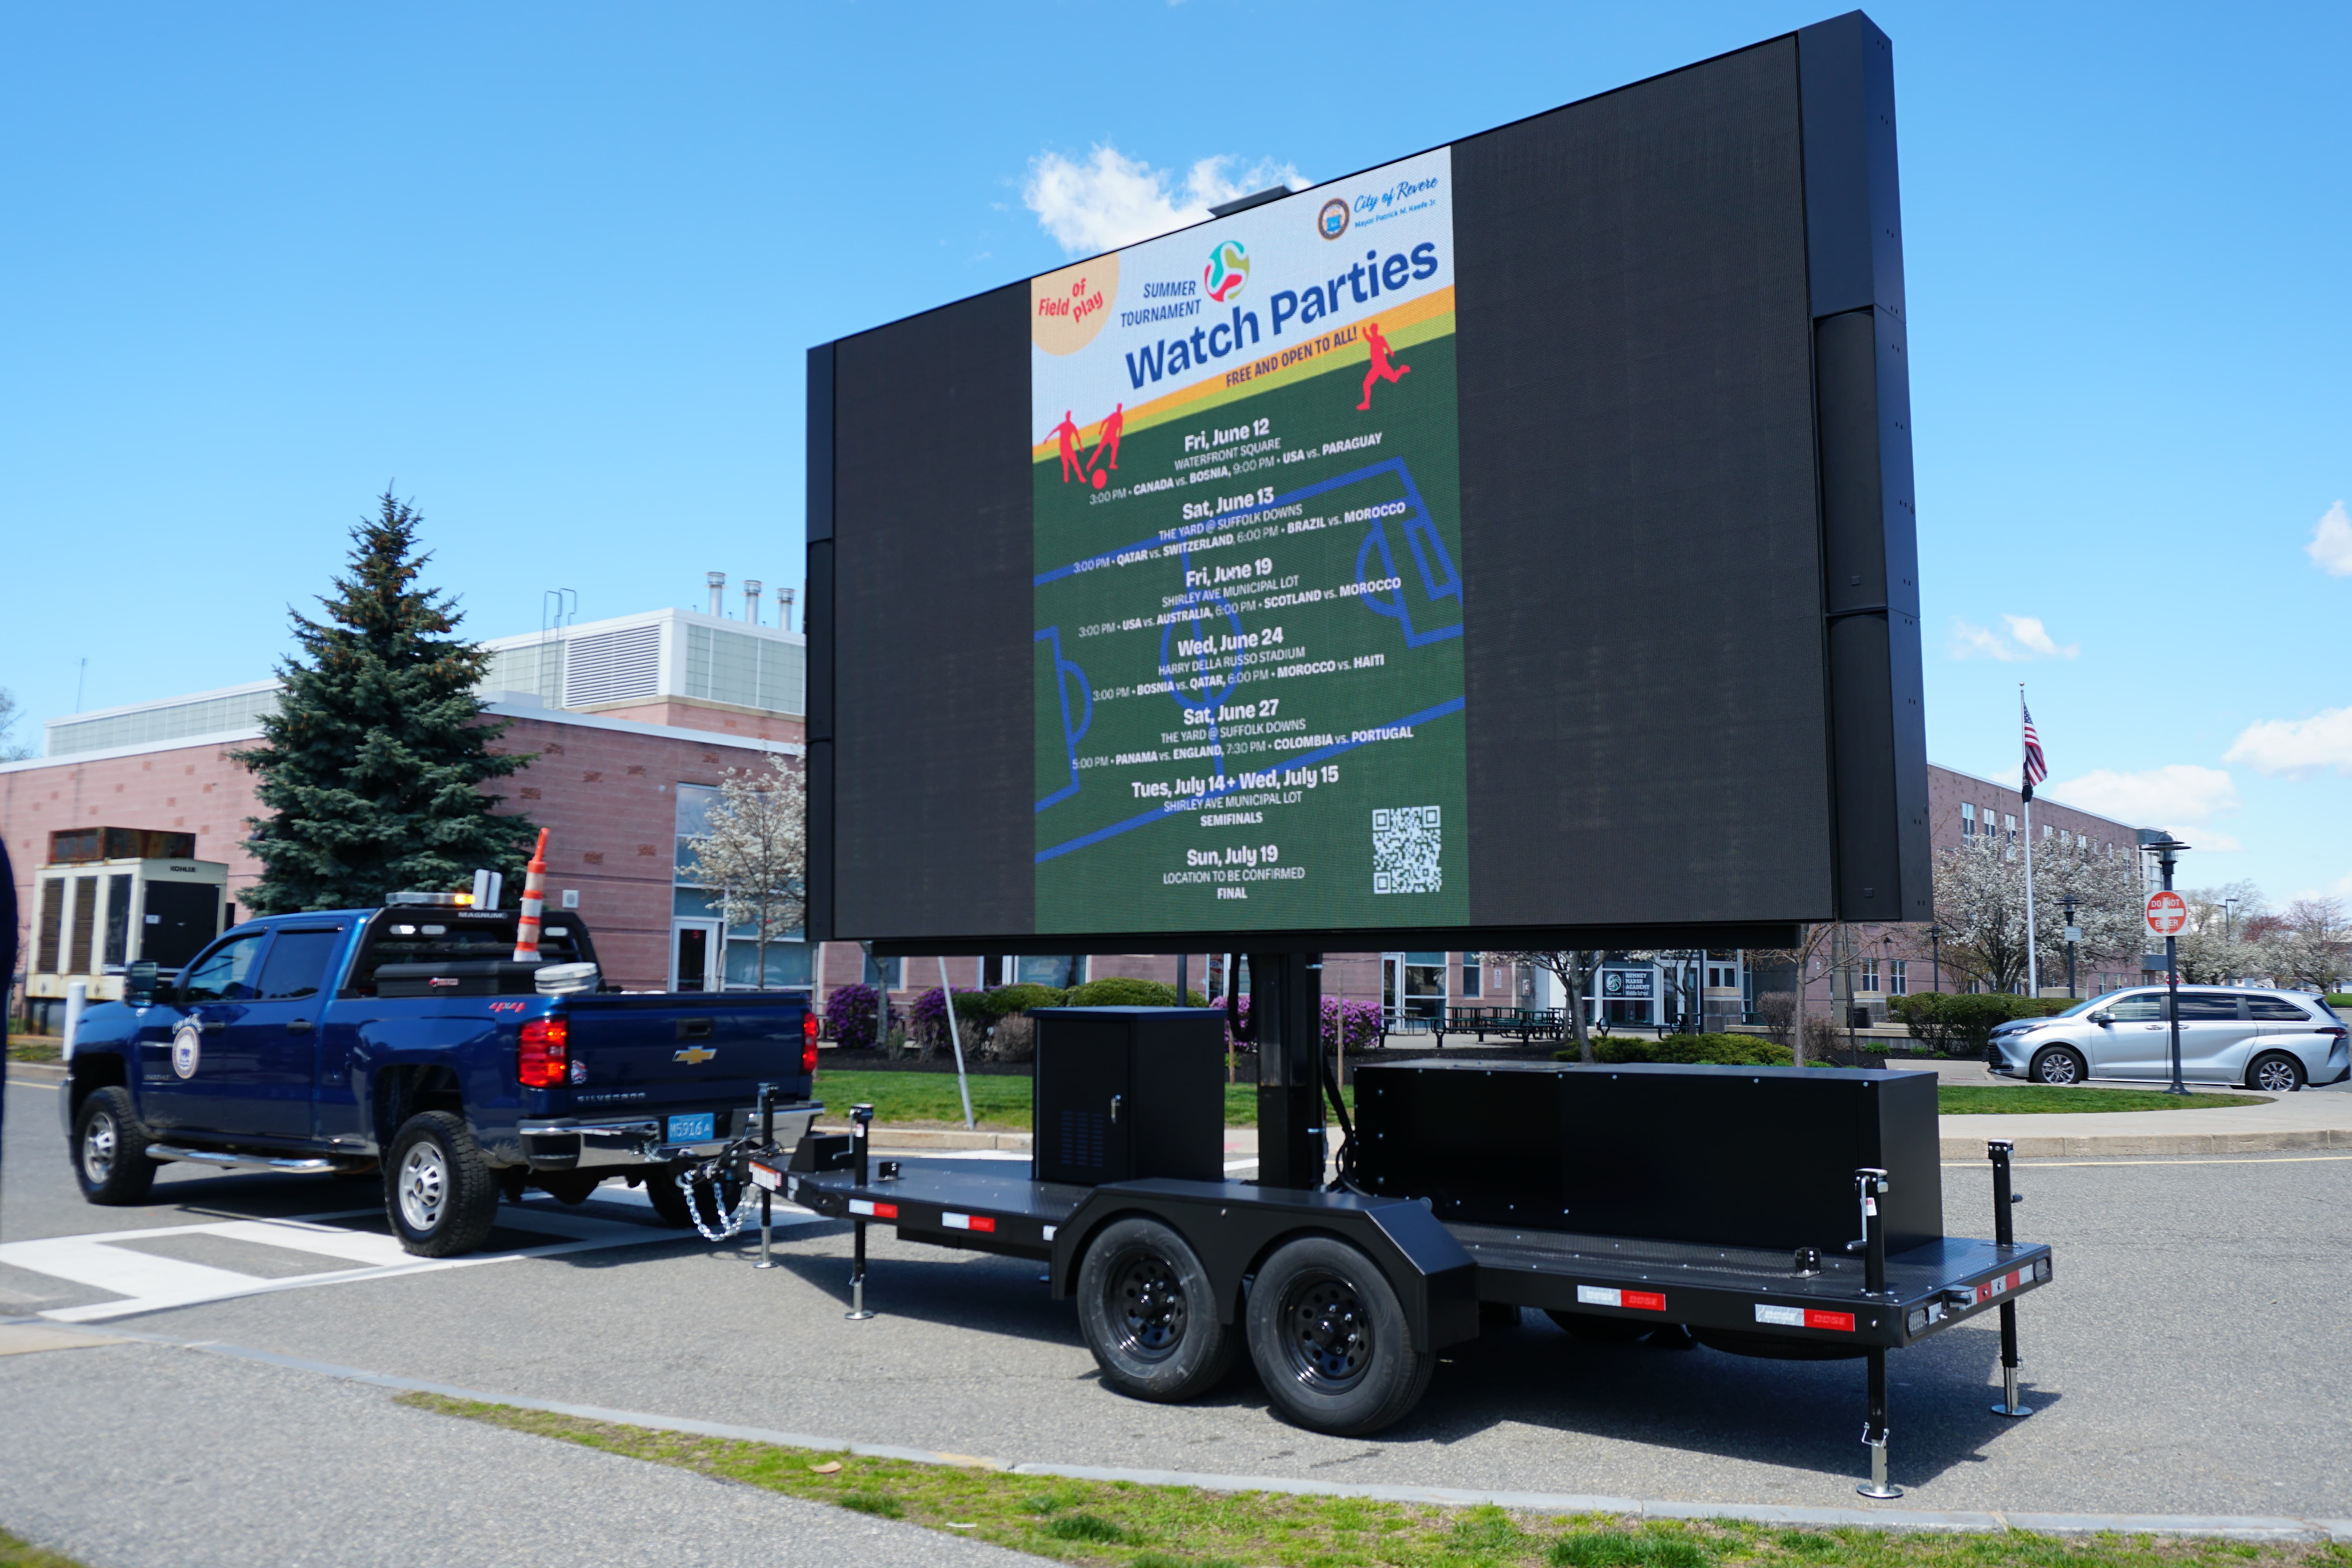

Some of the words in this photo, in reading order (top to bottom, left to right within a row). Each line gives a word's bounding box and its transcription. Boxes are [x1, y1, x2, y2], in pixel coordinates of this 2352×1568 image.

[1354, 194, 1378, 212] City
[1382, 188, 1394, 207] of
[1397, 178, 1438, 200] Revere
[1038, 297, 1070, 316] Field
[1072, 278, 1087, 297] of
[1143, 279, 1196, 298] SUMMER
[1121, 298, 1201, 327] TOURNAMENT
[1125, 305, 1260, 390] Watch
[1270, 241, 1438, 335] Parties
[1226, 365, 1252, 387] FREE
[1255, 356, 1278, 377] AND
[1281, 343, 1313, 367] OPEN
[1316, 336, 1330, 354] TO
[1334, 326, 1357, 347] ALL!
[1184, 430, 1210, 452] Fri,
[1212, 425, 1250, 446] June
[1252, 417, 1270, 437] 12
[1089, 490, 1112, 505] 3:00
[1112, 487, 1127, 500] PM
[1133, 477, 1174, 496] CANADA
[1189, 465, 1232, 484] BOSNIA,
[1233, 459, 1257, 475] 9:00
[1258, 455, 1275, 469] PM
[1282, 449, 1305, 464] USA
[1322, 432, 1383, 456] PARAGUAY
[1174, 446, 1238, 470] WATERFRONT
[1240, 437, 1281, 456] SQUARE
[1182, 500, 1214, 521] Sat,
[1216, 493, 1255, 514] June
[1256, 486, 1275, 505] 13
[1073, 560, 1095, 573] 3:00
[1095, 557, 1110, 568] PM
[1116, 549, 1149, 567] QATAR
[1237, 528, 1261, 543] 6:00
[1262, 525, 1279, 537] PM
[1287, 516, 1327, 534] BRAZIL
[1343, 501, 1406, 523] MOROCCO
[1158, 527, 1177, 541] THE
[1178, 523, 1205, 537] YARD
[1205, 519, 1216, 534] @
[1218, 512, 1261, 530] SUFFOLK
[1262, 503, 1303, 522] DOWNS
[1185, 566, 1212, 588] Fri,
[1213, 563, 1252, 583] June
[1254, 557, 1273, 576] 19
[1078, 624, 1100, 638] 3:00
[1101, 622, 1116, 634] PM
[1122, 617, 1143, 631] USA
[1156, 606, 1214, 627] AUSTRALIA,
[1240, 600, 1256, 613] PM
[1263, 589, 1323, 609] SCOTLAND
[1339, 576, 1402, 597] MOROCCO
[1162, 592, 1201, 608] SHIRLEY
[1202, 588, 1221, 601] AVE
[1223, 579, 1279, 598] MUNICIPAL
[1280, 574, 1299, 589] LOT
[1177, 635, 1218, 657] Wed,
[1220, 632, 1259, 652] June
[1261, 626, 1284, 646] 24
[1092, 688, 1115, 702] 3:00
[1115, 686, 1131, 698] PM
[1136, 680, 1175, 696] BOSNIA
[1227, 671, 1252, 684] 6:00
[1252, 669, 1269, 681] PM
[1277, 659, 1337, 679] MOROCCO
[1353, 653, 1385, 669] HAITI
[1158, 662, 1191, 676] HARRY
[1191, 657, 1222, 672] DELLA
[1223, 652, 1258, 667] RUSSO
[1259, 646, 1306, 663] STADIUM
[1183, 707, 1215, 726] Sat,
[1217, 704, 1256, 722] June
[1258, 698, 1280, 718] 27
[1094, 755, 1109, 767] PM
[1115, 750, 1159, 765] PANAMA
[1249, 740, 1267, 752] PM
[1273, 733, 1334, 751] COLOMBIA
[1351, 726, 1414, 743] PORTUGAL
[1160, 731, 1180, 744] THE
[1180, 728, 1207, 742] YARD
[1208, 727, 1219, 741] @
[1220, 723, 1265, 739] SUFFOLK
[1265, 718, 1307, 734] DOWNS
[1131, 781, 1173, 799] Tues,
[1174, 775, 1206, 798] July
[1238, 769, 1281, 790] Wed,
[1283, 766, 1318, 789] July
[1320, 764, 1339, 784] 15
[1163, 798, 1203, 812] SHIRLEY
[1204, 796, 1223, 809] AVE
[1225, 793, 1282, 808] MUNICIPAL
[1283, 790, 1303, 804] LOT
[1200, 811, 1264, 827] SEMIFINALS
[1186, 848, 1223, 867] Sun,
[1224, 845, 1258, 868] July
[1259, 844, 1279, 863] 19
[1163, 871, 1211, 885] LOCATION
[1212, 870, 1227, 882] TO
[1227, 869, 1241, 882] BE
[1242, 866, 1306, 882] CONFIRMED
[1216, 887, 1248, 900] FINAL
[577, 1092, 646, 1103] SILVERADO
